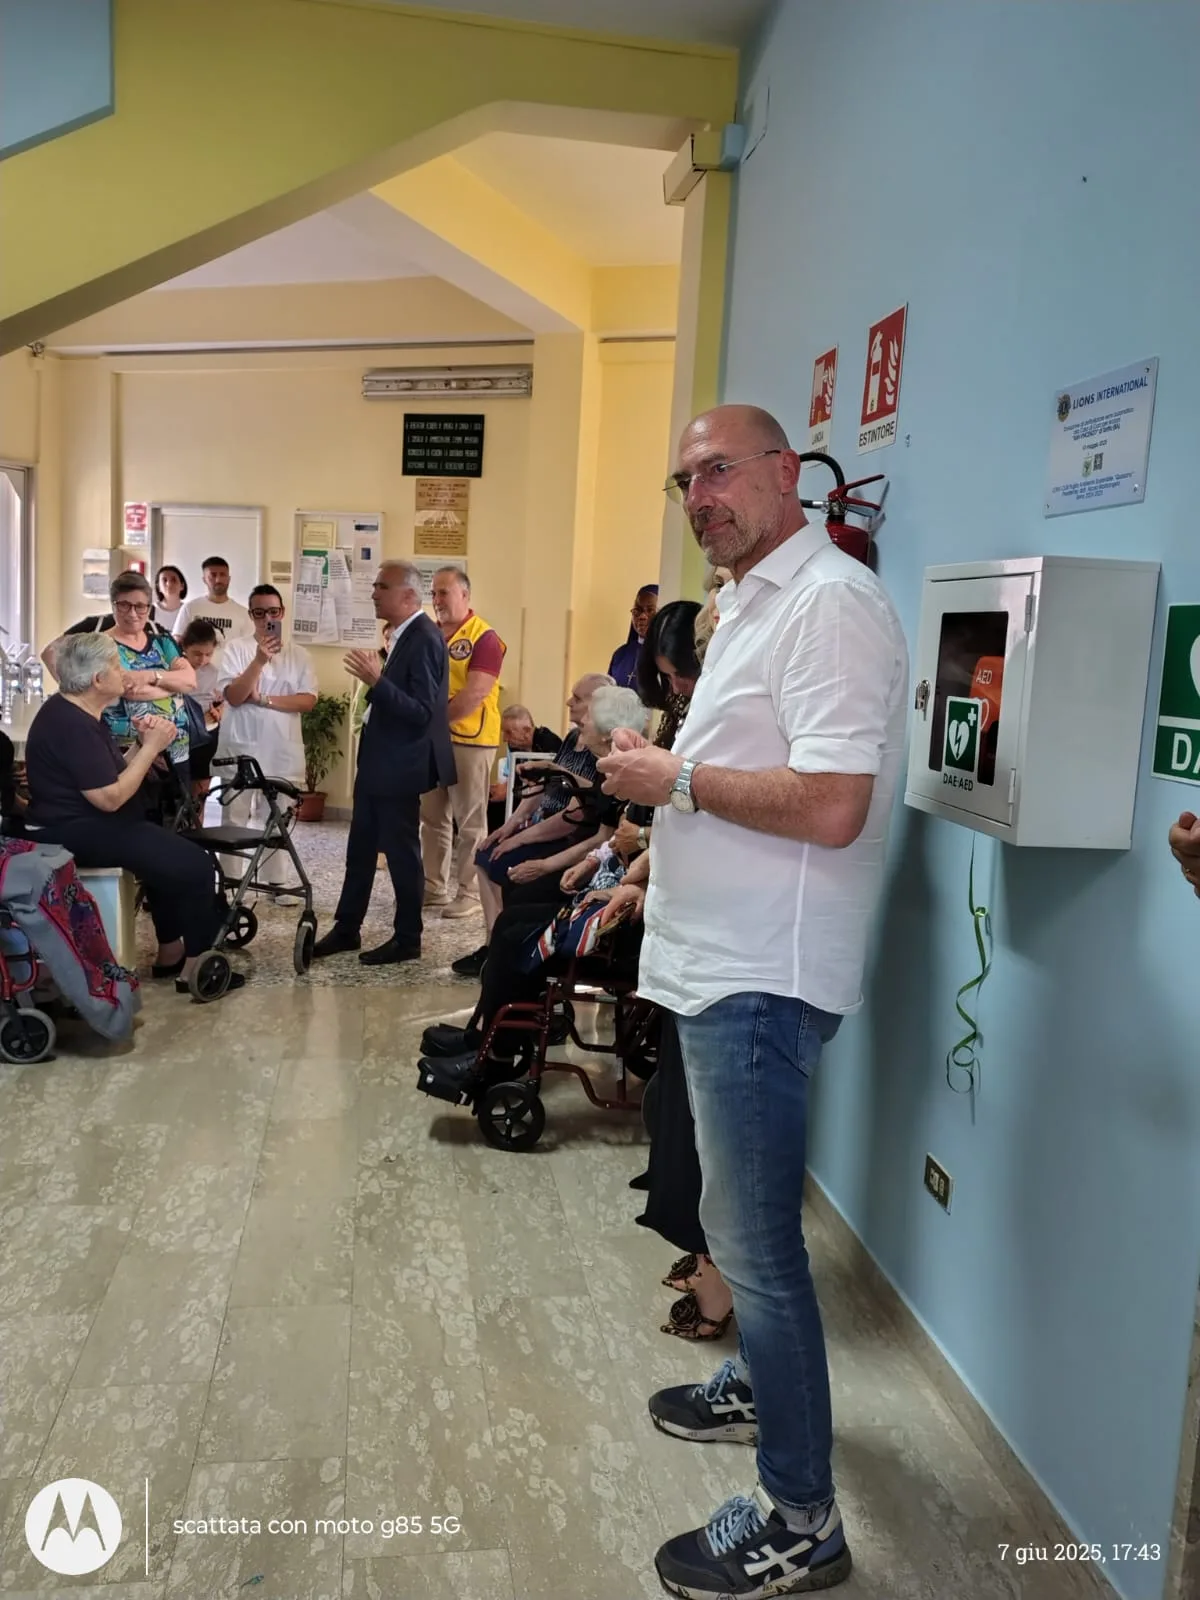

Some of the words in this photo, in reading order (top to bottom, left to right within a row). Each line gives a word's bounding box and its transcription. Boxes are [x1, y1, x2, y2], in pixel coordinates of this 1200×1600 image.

[1072, 392, 1095, 410] LIONS
[1096, 375, 1148, 402] INTERNATIONAL
[858, 420, 895, 447] ESTINTORE
[975, 667, 993, 685] AED
